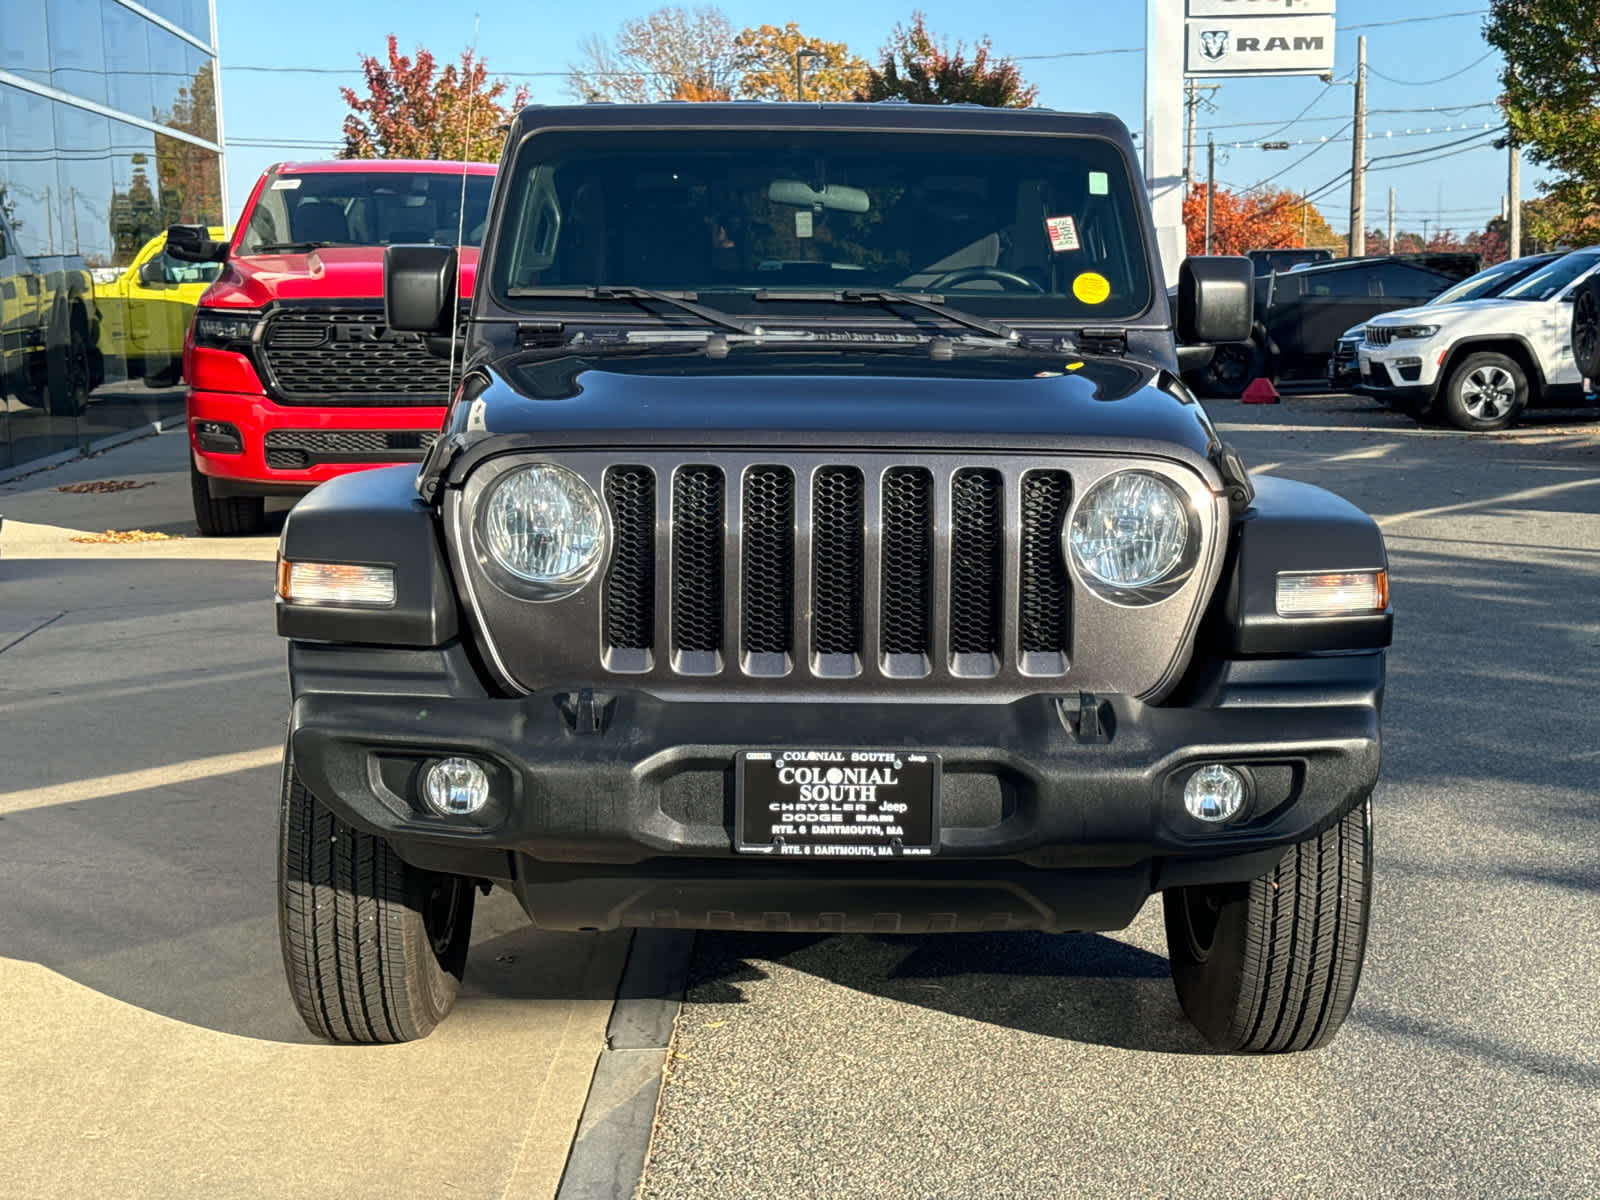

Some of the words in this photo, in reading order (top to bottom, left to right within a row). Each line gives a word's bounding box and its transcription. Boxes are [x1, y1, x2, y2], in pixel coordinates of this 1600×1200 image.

[1236, 36, 1324, 52] RAM
[851, 752, 895, 762] SOUTH
[778, 767, 898, 785] COLONIAL
[799, 785, 877, 802] SOUTH
[768, 803, 867, 812] CHRYSLER
[878, 801, 908, 813] Jeep
[781, 813, 844, 823] DODGE
[855, 814, 895, 823] RAM
[771, 825, 797, 834] RTE.
[799, 825, 807, 834] 6
[811, 825, 884, 836] DARTMOUTH,
[886, 826, 904, 835] MA
[780, 846, 803, 855] RTE.
[814, 846, 876, 856] DARTMOUTH,
[878, 847, 893, 856] MA
